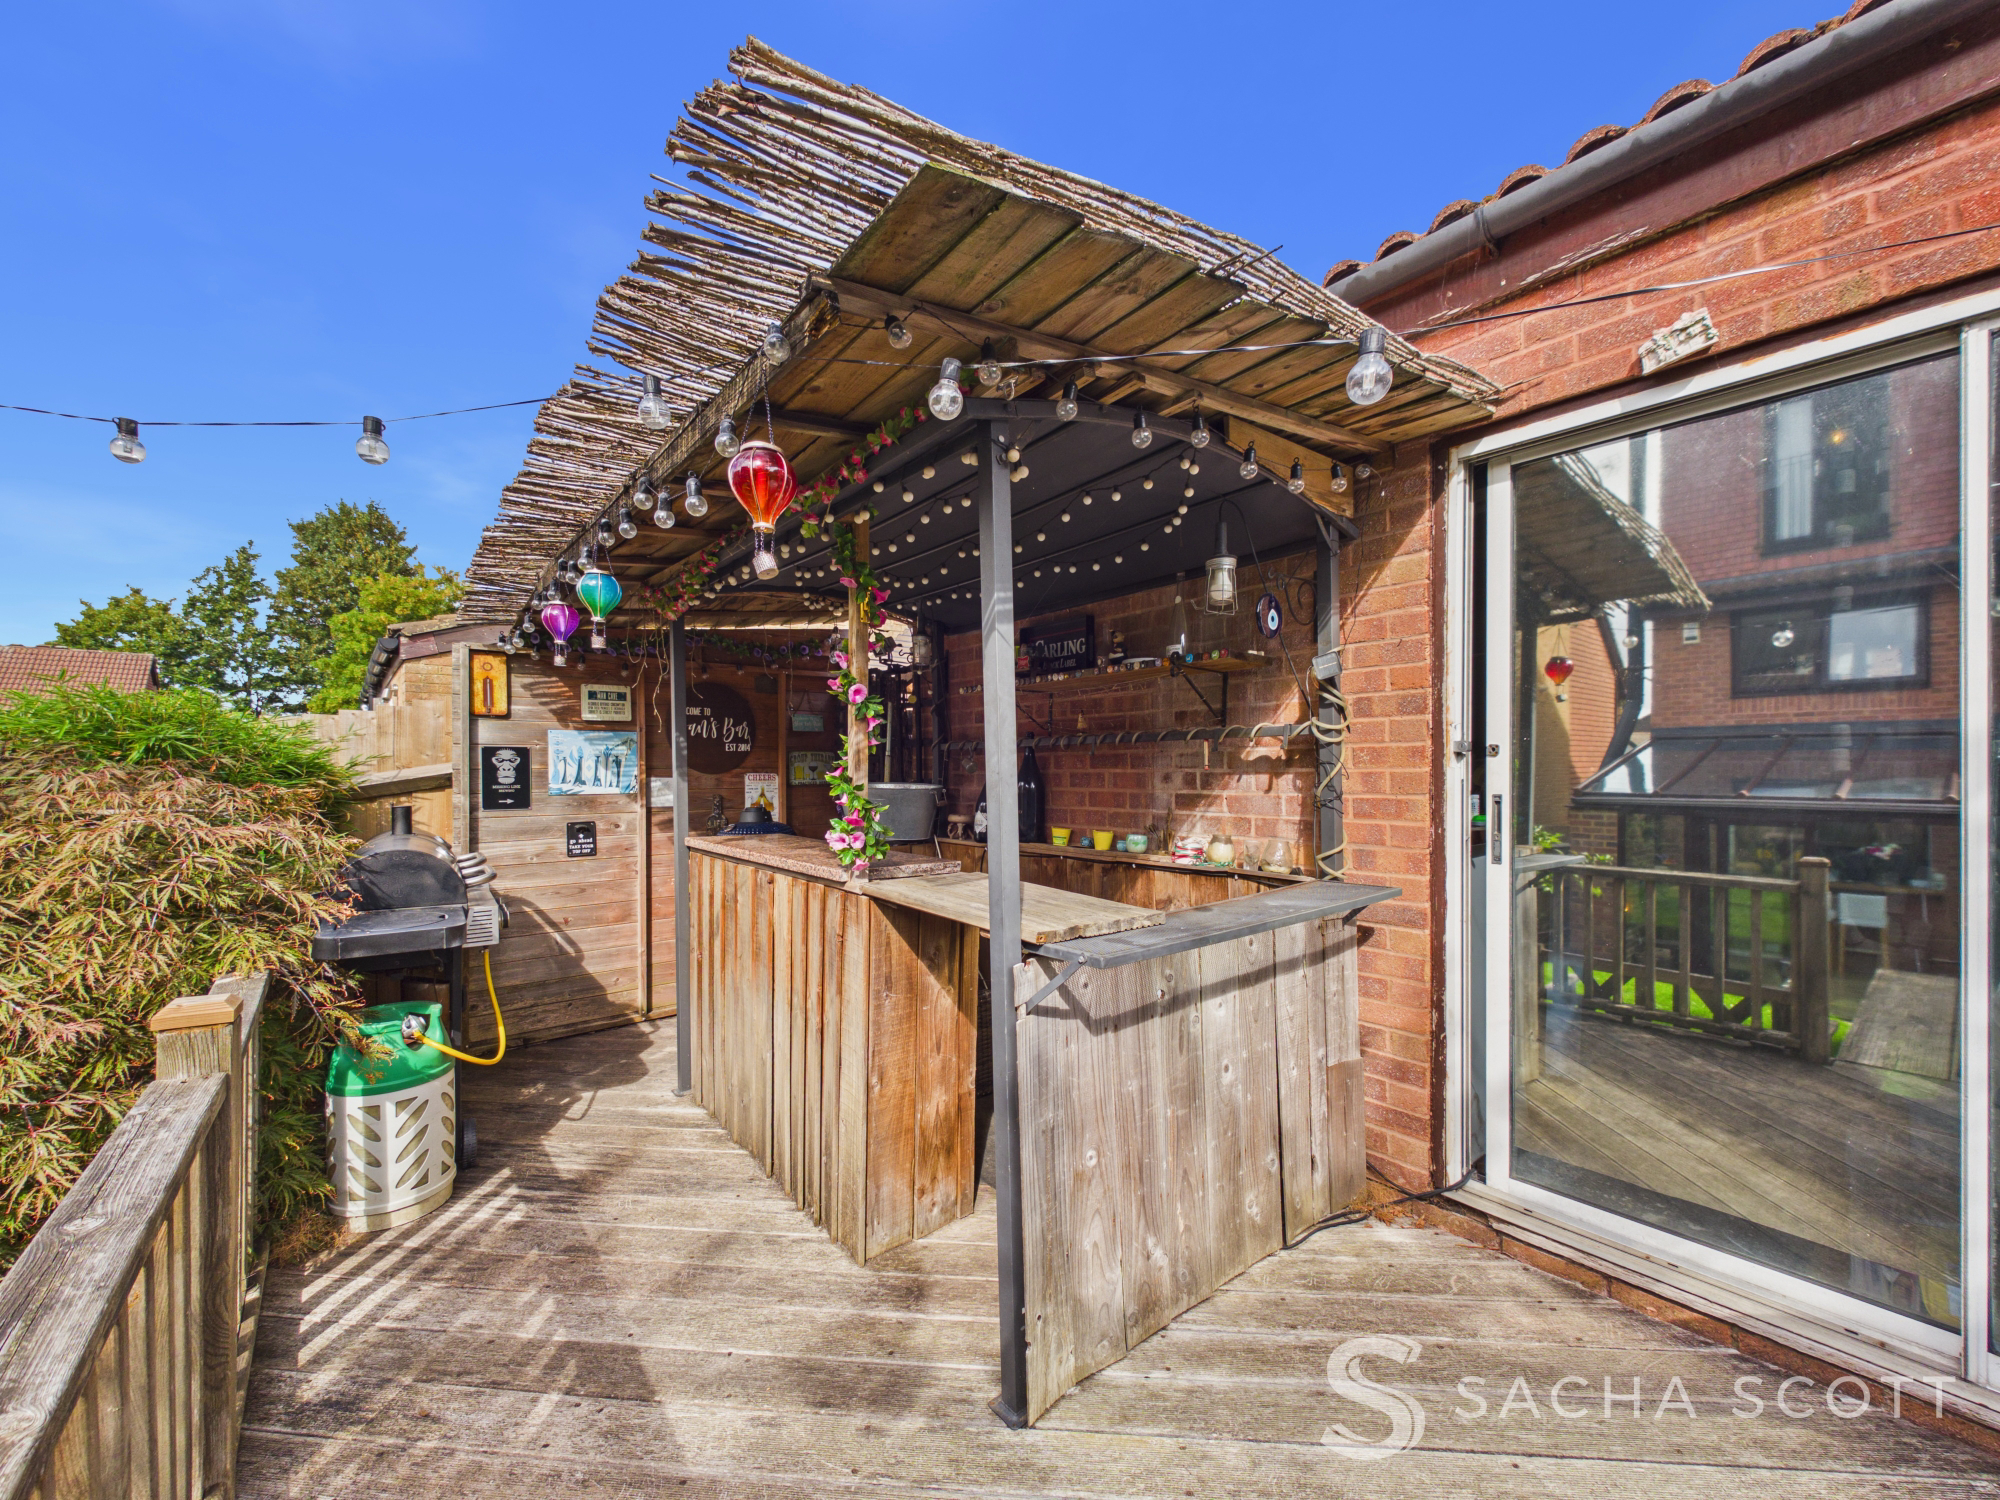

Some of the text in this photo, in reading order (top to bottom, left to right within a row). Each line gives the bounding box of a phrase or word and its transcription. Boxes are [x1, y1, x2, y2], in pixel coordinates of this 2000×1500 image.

[1060, 658, 1077, 669] LABEL
[686, 706, 711, 716] COME TO
[687, 717, 752, 745] an's Bar
[725, 743, 737, 752] EST
[747, 773, 777, 782] CHEERS
